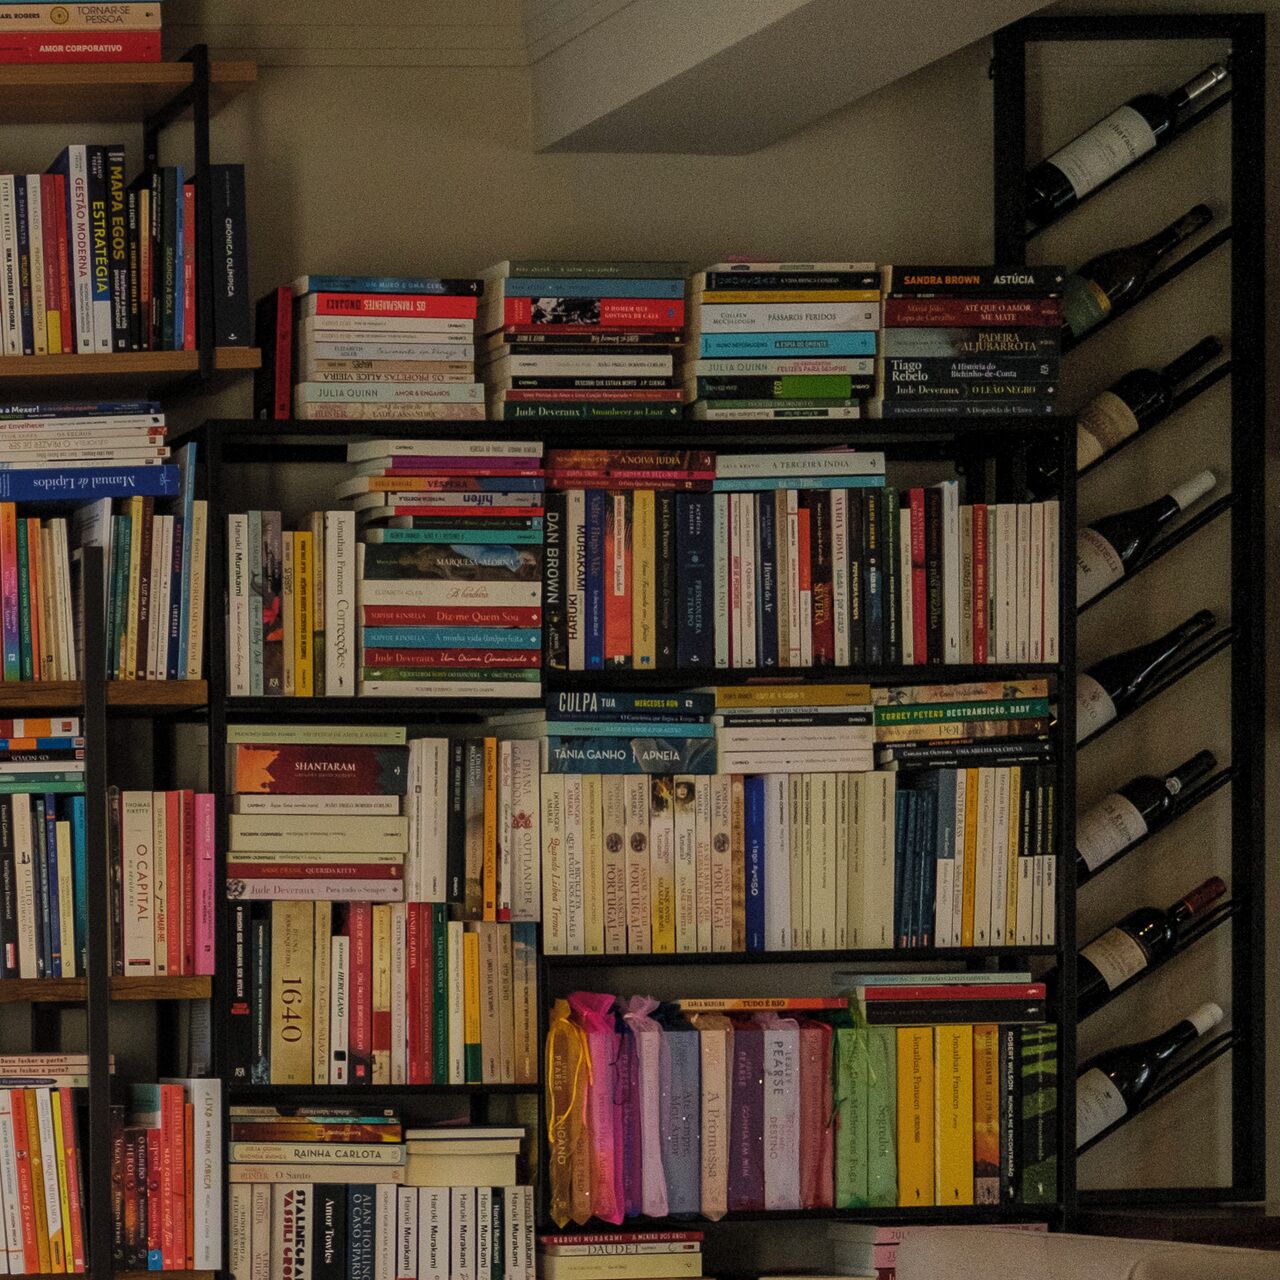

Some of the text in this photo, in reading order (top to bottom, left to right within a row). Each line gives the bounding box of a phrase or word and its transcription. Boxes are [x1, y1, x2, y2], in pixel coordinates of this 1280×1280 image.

[78, 6, 129, 14] TORNAR-SE
[86, 15, 122, 23] PESSOA
[74, 178, 87, 277] GESTÃO MODERNA
[111, 167, 124, 259] MAPA EGOS
[92, 202, 107, 293] ESTRATÉGIA
[225, 218, 234, 297] CRÓNICA OLÍMPICA
[904, 274, 1034, 285] SANDRA BROWN ASTÚCIA
[892, 360, 921, 371] Tiago
[892, 371, 928, 381] Rebelo
[516, 407, 536, 416] Jude
[34, 476, 134, 488] Manual de Lípidos
[547, 513, 558, 602] DAN BROWN
[576, 525, 585, 591] MURAKAMI
[335, 599, 348, 668] Correcções
[569, 594, 577, 640] HARUKI
[559, 693, 597, 713] CULPA
[601, 698, 615, 708] TUA
[295, 762, 355, 771] SHANTARAM
[555, 749, 680, 760] TÂNIA GANHO APNEIA
[138, 845, 148, 922] O CAPITAL
[524, 834, 532, 904] OUTLANDER
[282, 977, 303, 1043] 1640
[773, 1041, 783, 1095] PEARSE
[294, 1150, 381, 1158] RAINHA CARLOTA
[283, 1190, 292, 1243] VASSILI
[325, 1198, 333, 1263] Amor Towles
[362, 1195, 370, 1224] ALAN
